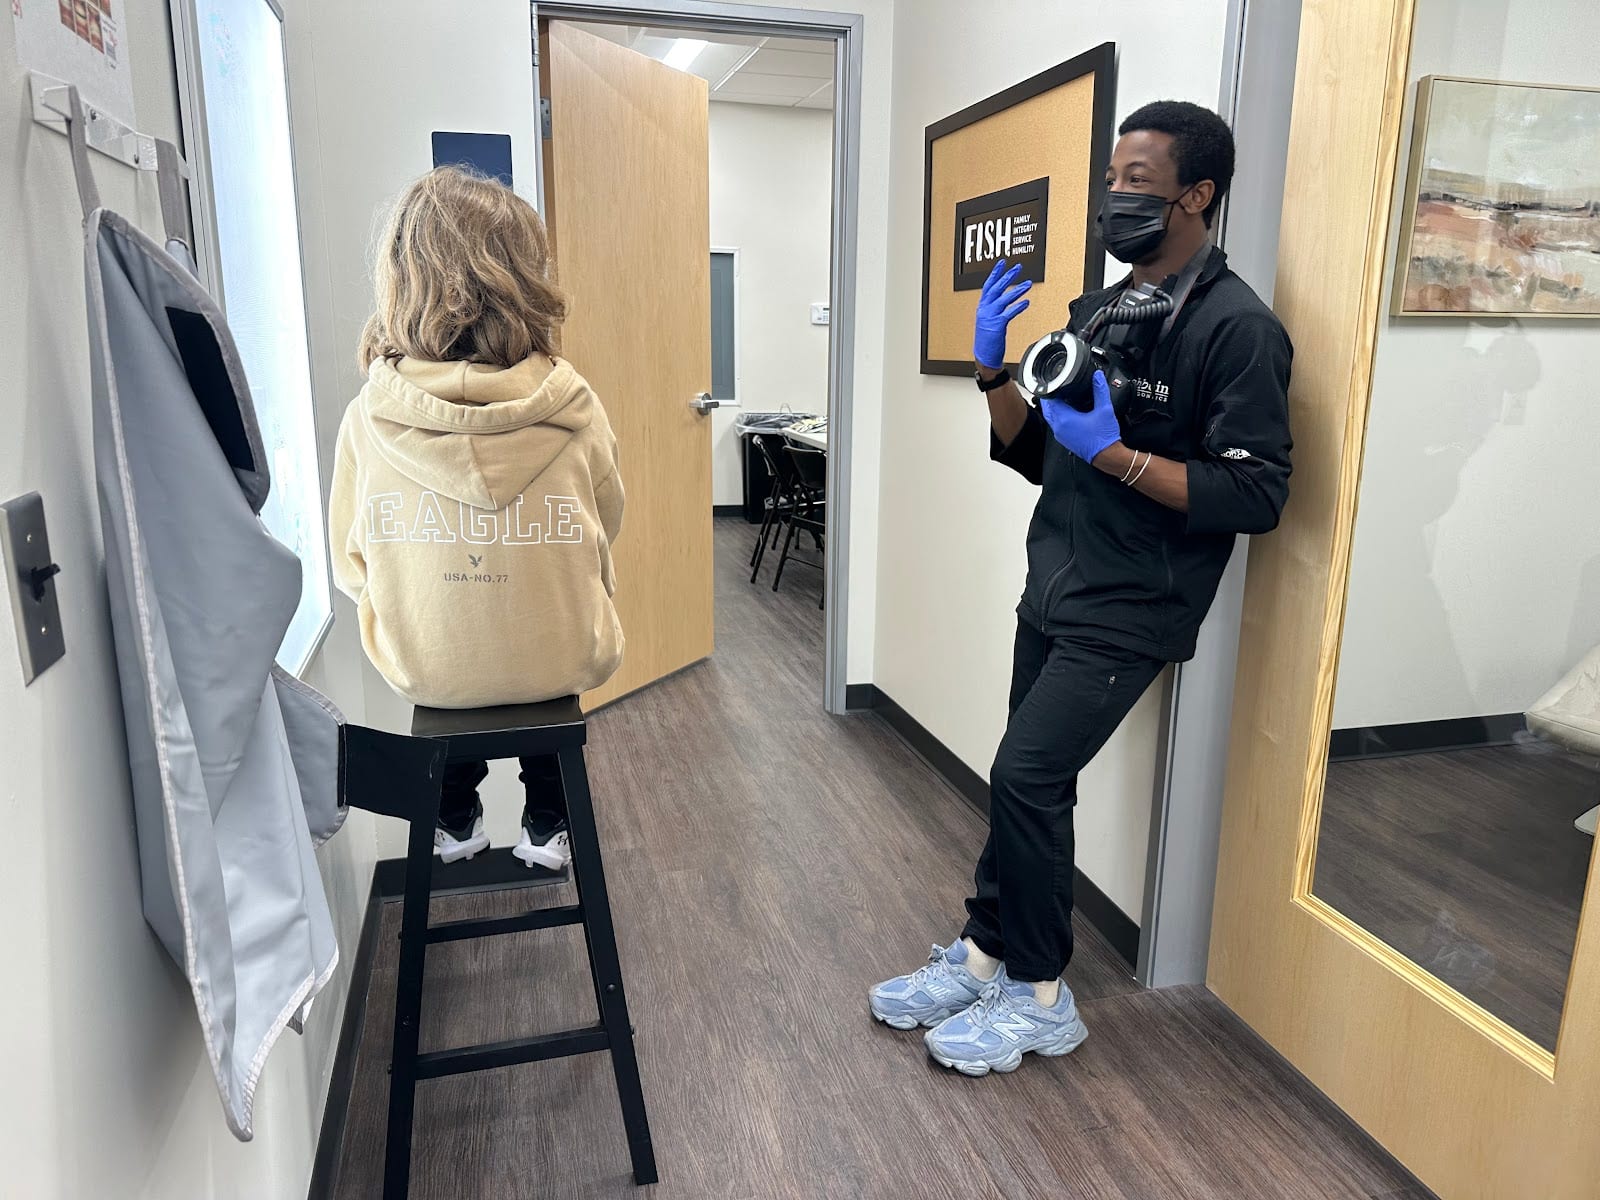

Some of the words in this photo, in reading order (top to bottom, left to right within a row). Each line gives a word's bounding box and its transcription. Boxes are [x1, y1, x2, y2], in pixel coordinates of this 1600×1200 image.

[1013, 214, 1031, 224] FAMILY
[1013, 223, 1038, 234] INTEGRITY
[965, 217, 1011, 263] FISH
[1012, 234, 1032, 245] SERVICE
[1012, 245, 1035, 255] HUMILITY
[368, 491, 583, 544] EAGLE
